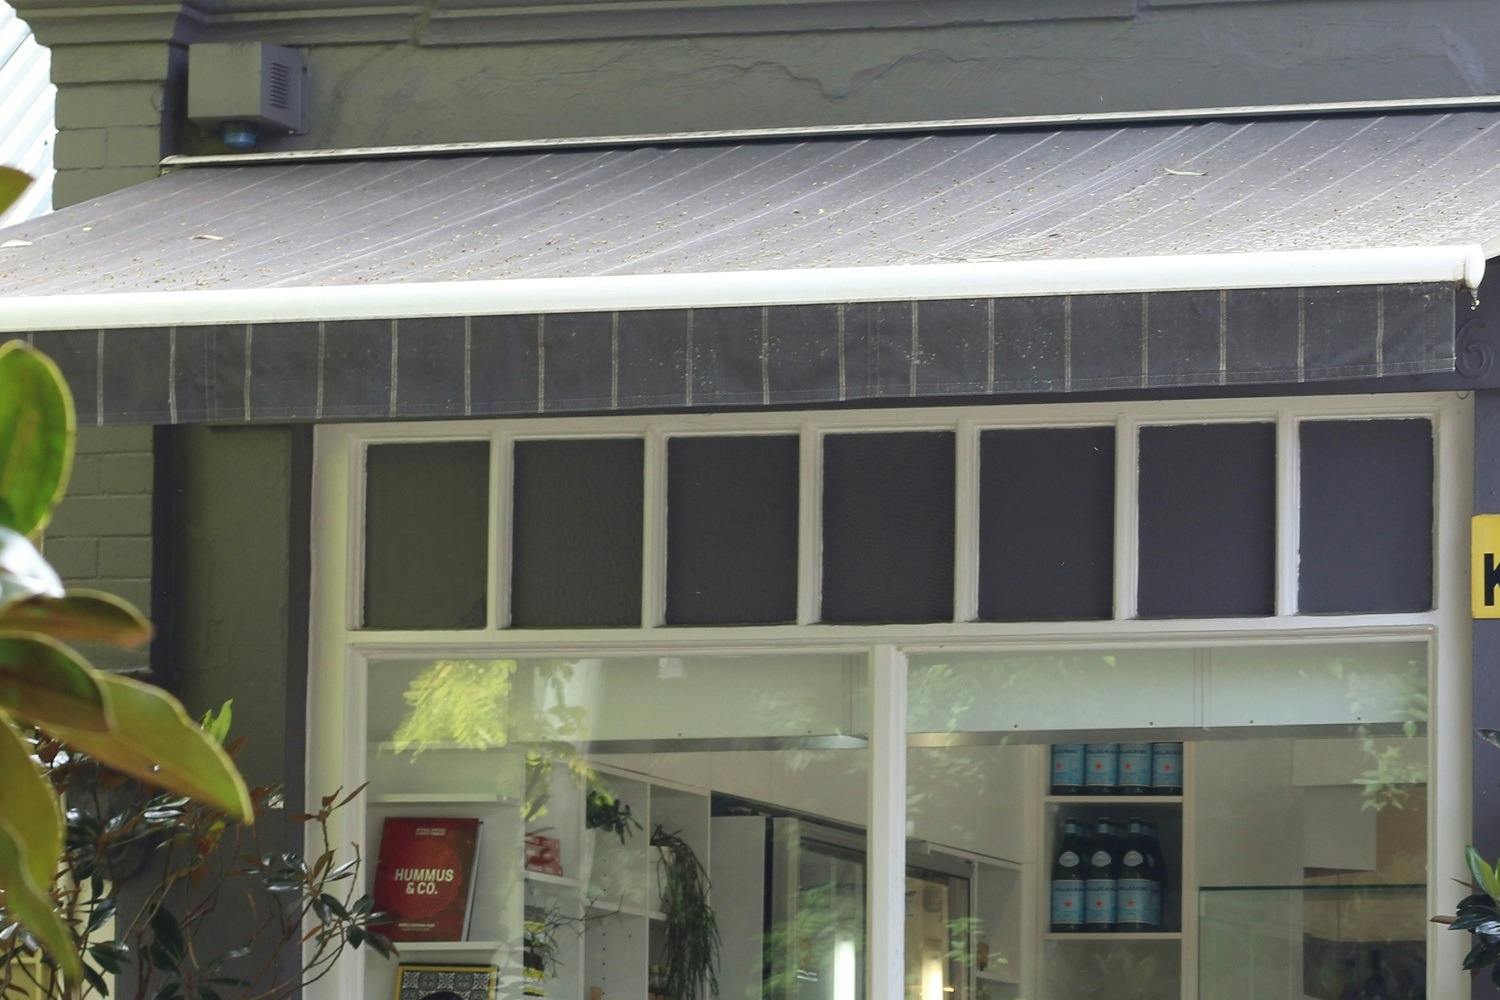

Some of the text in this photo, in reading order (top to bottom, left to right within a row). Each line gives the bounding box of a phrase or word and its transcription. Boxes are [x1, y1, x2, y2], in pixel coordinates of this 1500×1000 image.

[395, 868, 455, 882] HUMMUS
[406, 882, 439, 895] & CO.
